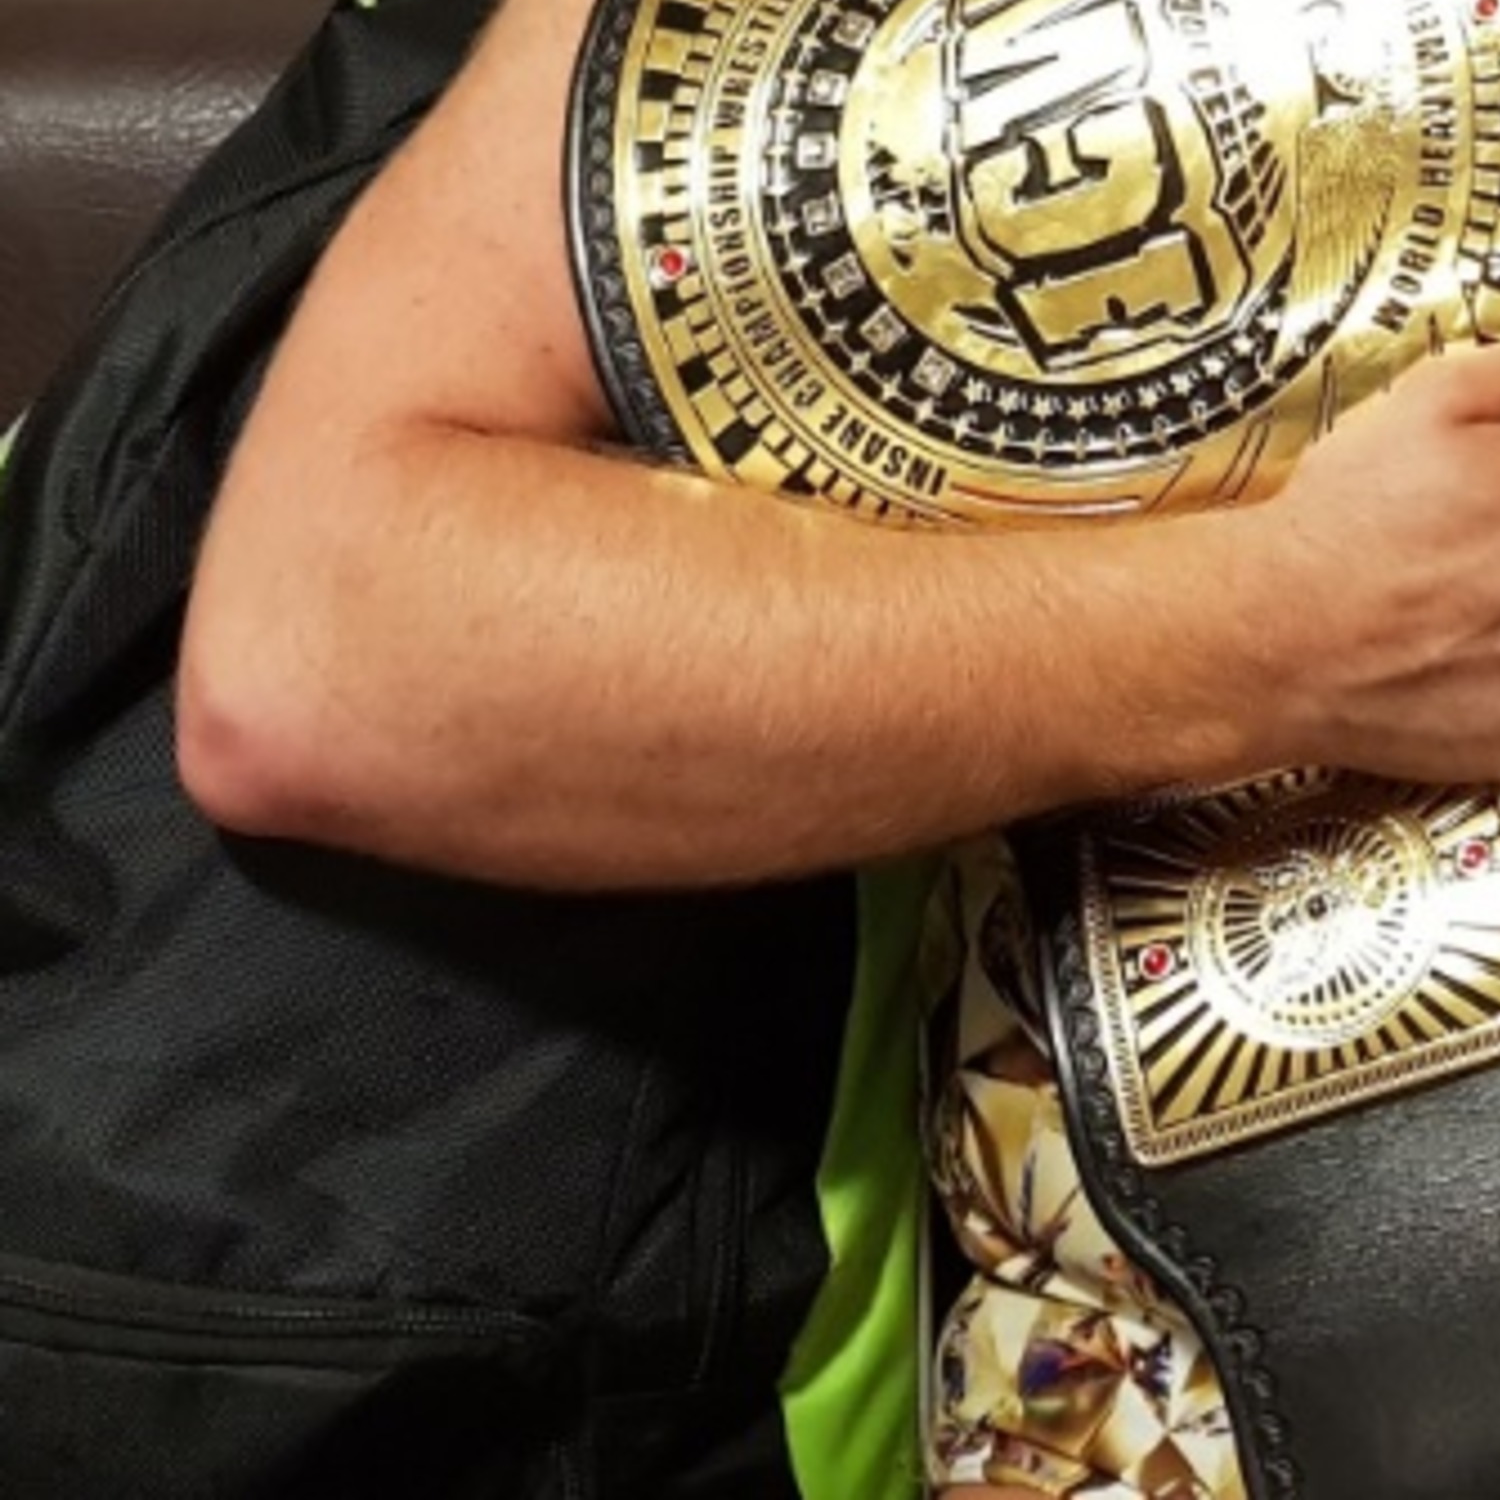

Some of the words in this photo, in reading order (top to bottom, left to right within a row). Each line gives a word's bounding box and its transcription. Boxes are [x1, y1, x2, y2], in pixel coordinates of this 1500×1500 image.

[707, 145, 823, 410] CHAMPIONSHIP
[1371, 203, 1446, 336] WORLD
[820, 403, 948, 498] INSANE
